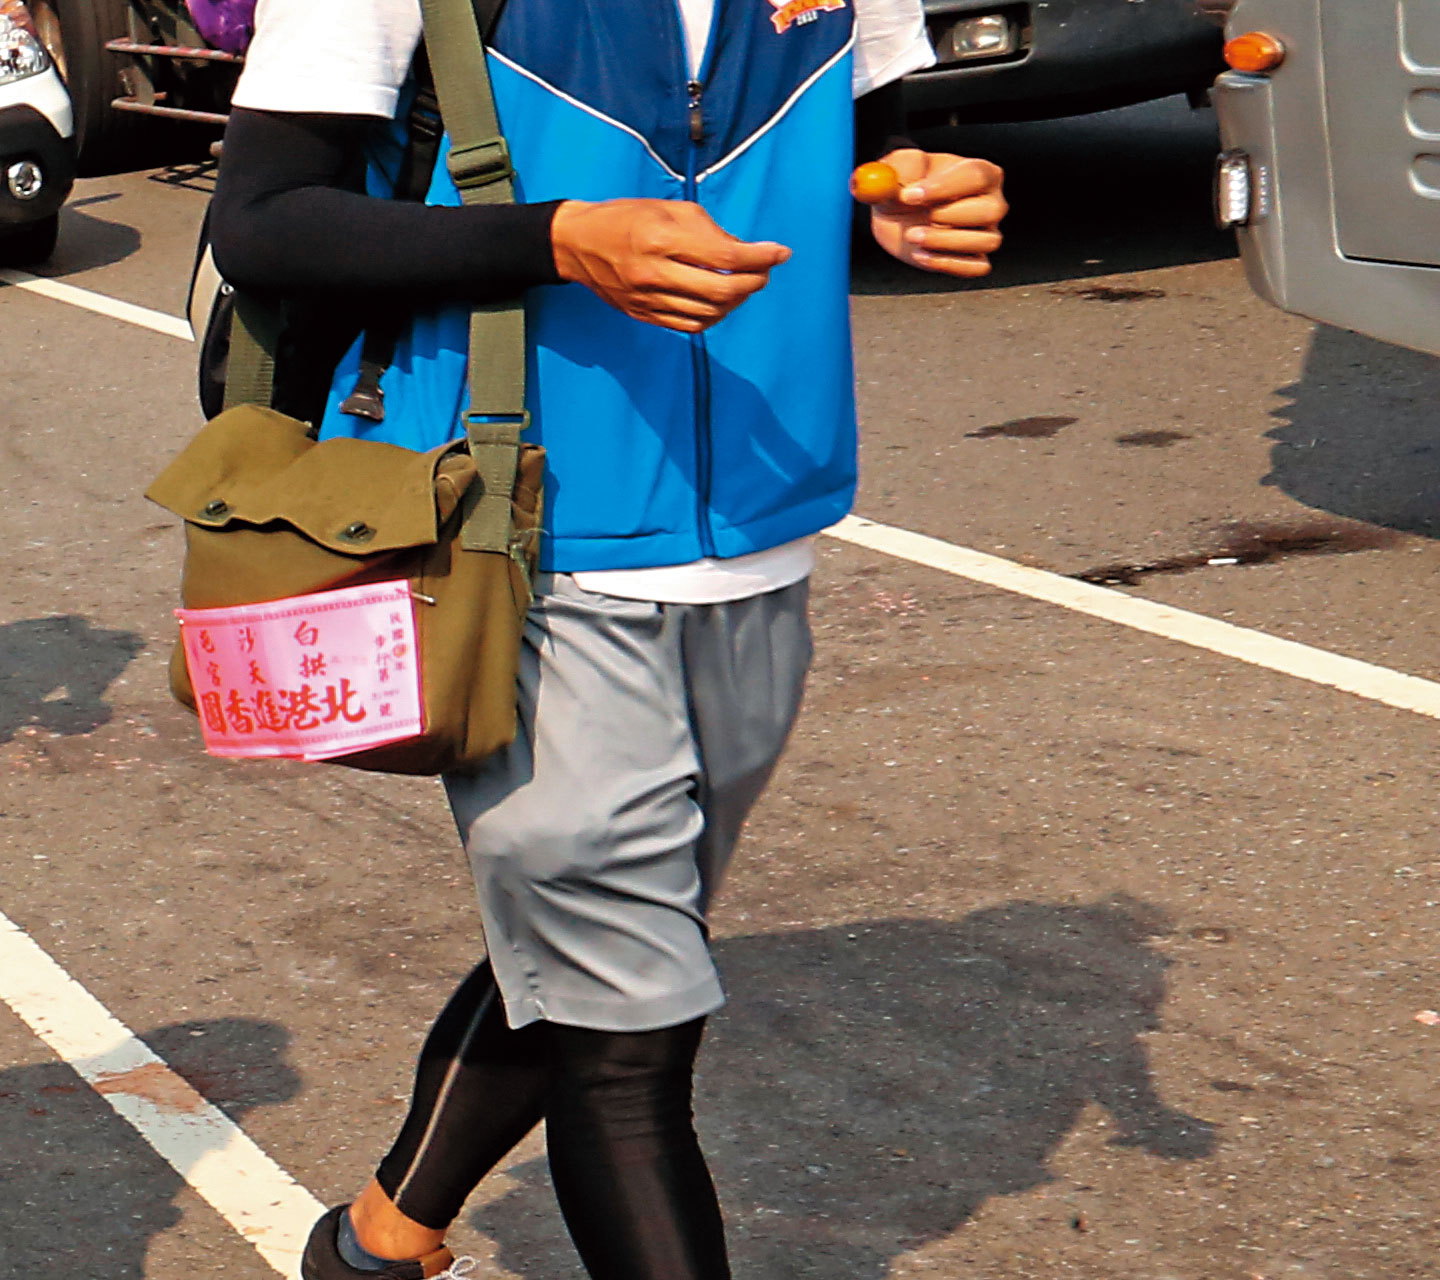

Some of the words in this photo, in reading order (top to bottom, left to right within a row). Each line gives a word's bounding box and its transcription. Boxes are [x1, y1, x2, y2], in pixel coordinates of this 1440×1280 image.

[199, 621, 319, 654] 白沙屯
[206, 652, 327, 687] 拱天宮
[200, 676, 367, 736] 北港進香團
